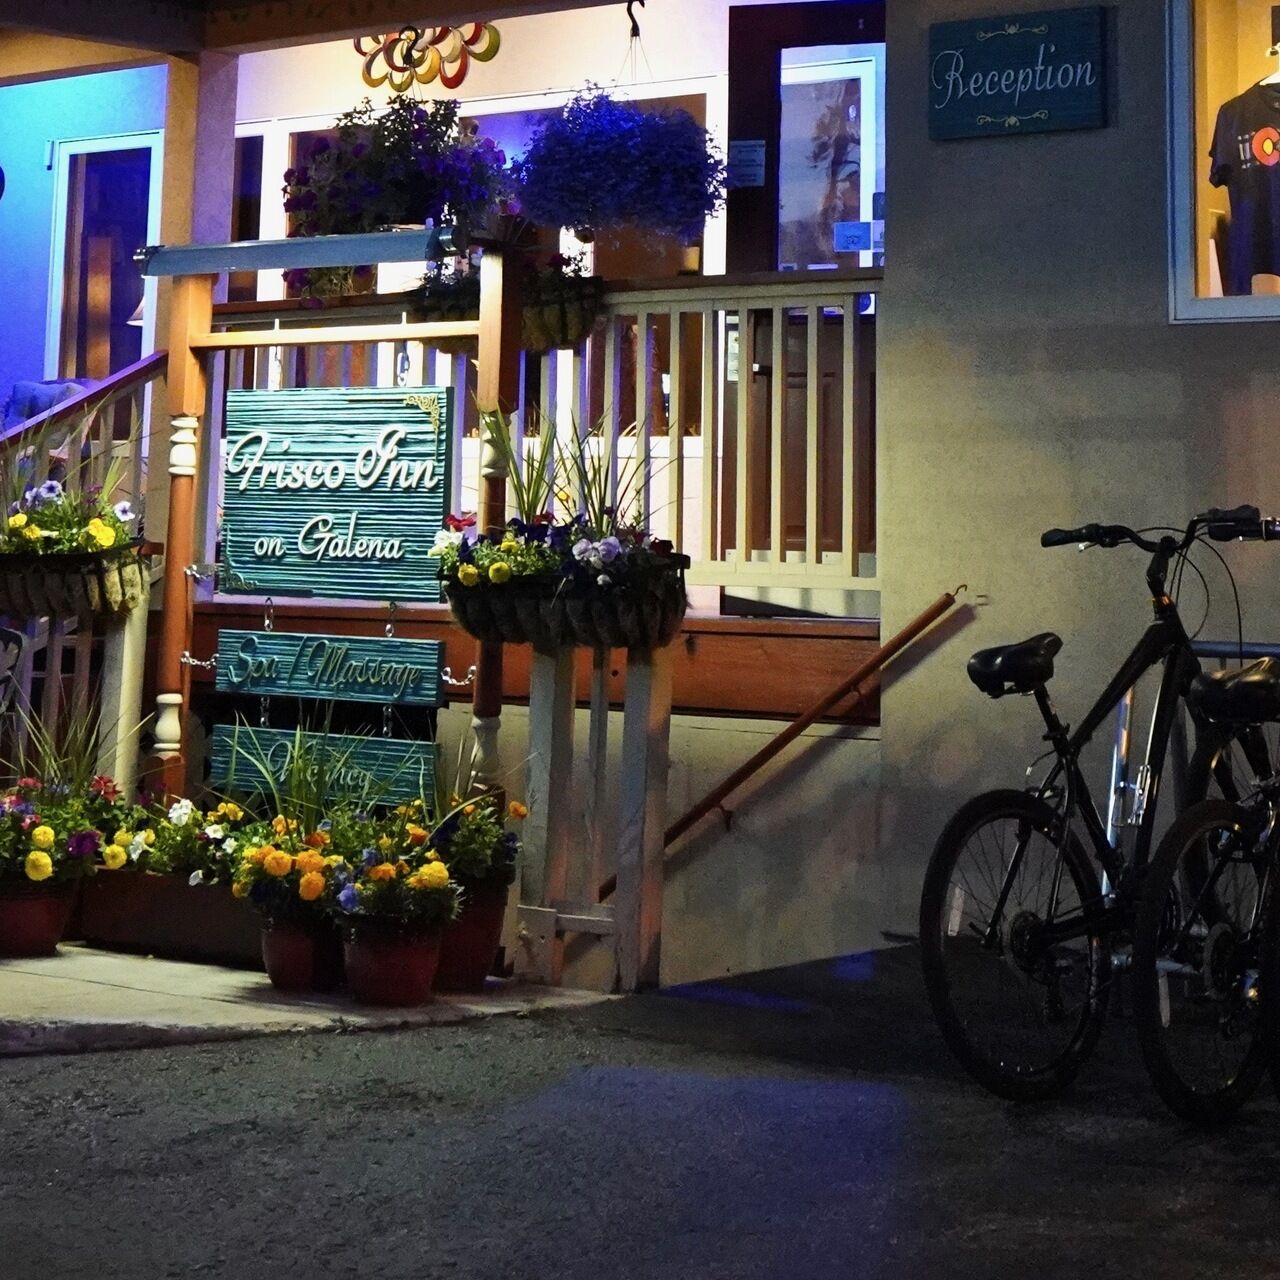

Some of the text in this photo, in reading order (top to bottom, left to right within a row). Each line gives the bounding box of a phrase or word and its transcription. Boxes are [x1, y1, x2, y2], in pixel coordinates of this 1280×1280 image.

[931, 43, 1096, 109] Reception
[227, 424, 440, 492] Frisco Inn
[254, 510, 405, 562] on Galena
[227, 635, 280, 688] Spa
[307, 639, 422, 698] Massage
